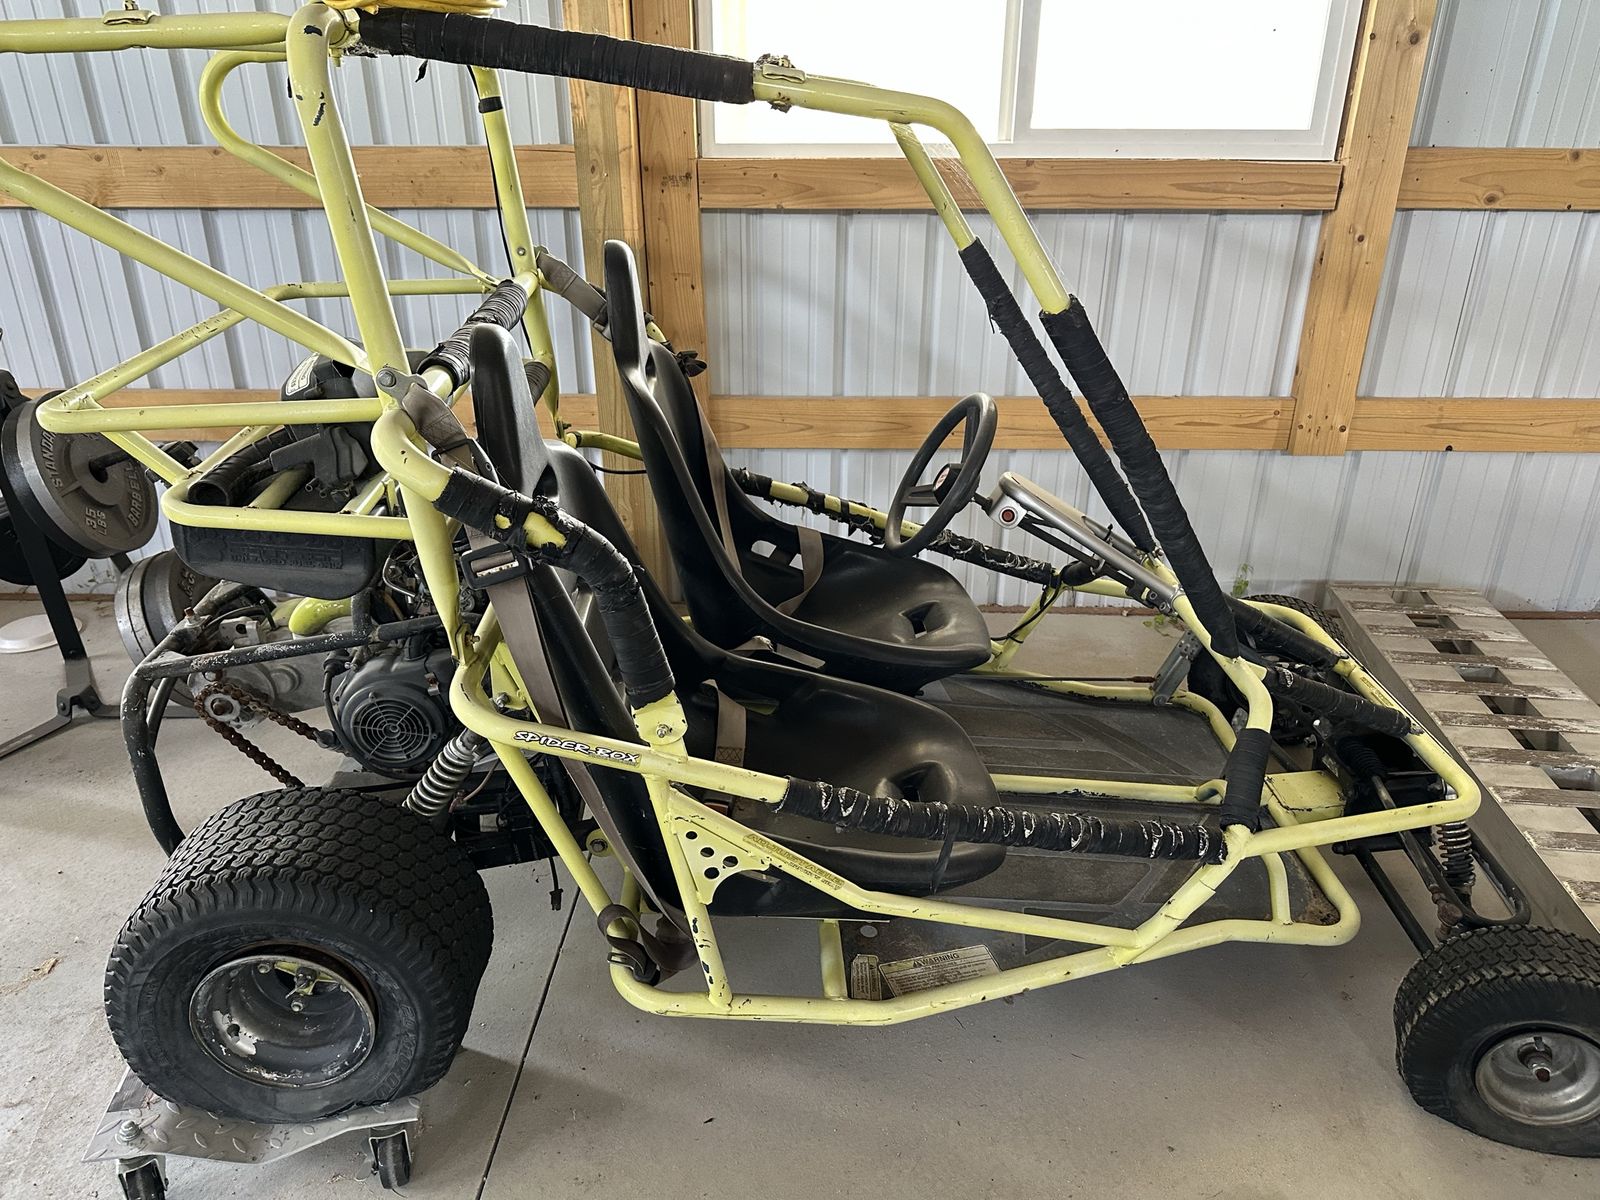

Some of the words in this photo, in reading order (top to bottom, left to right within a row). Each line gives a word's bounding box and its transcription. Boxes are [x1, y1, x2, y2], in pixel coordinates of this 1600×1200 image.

[124, 461, 144, 527] BARBELL
[85, 507, 98, 530] 35
[97, 511, 108, 536] LBS
[514, 730, 640, 763] SPIDER-BOX
[921, 952, 960, 967] WARNING
